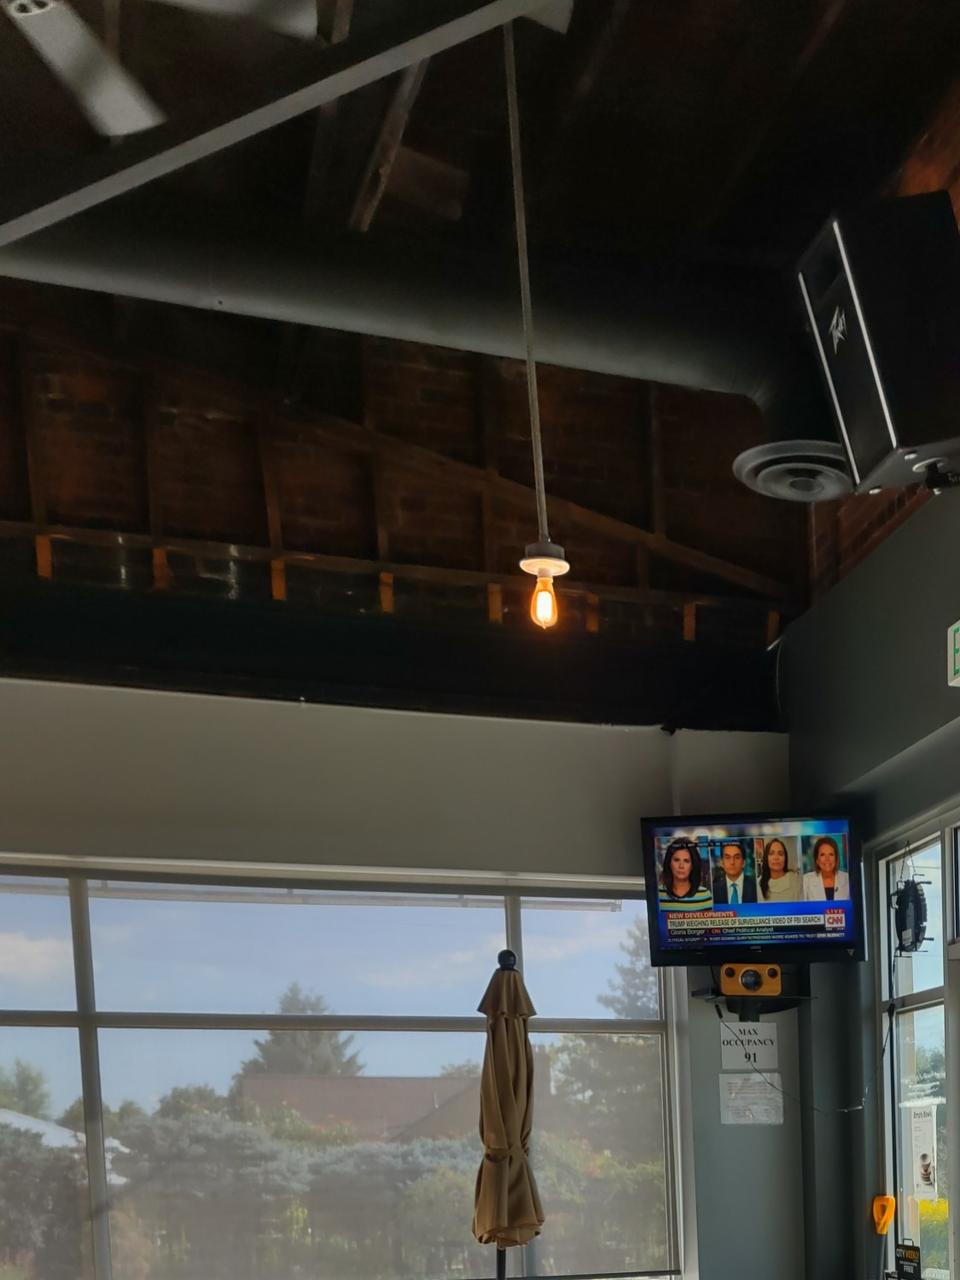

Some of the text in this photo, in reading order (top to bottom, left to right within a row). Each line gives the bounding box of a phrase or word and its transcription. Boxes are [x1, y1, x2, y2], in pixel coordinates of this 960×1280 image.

[738, 917, 770, 926] SURVEILLANCE
[786, 916, 793, 924] OF
[827, 916, 843, 925] CNN
[738, 1028, 759, 1036] MAX
[722, 1038, 775, 1047] OCCUPANCY
[744, 1052, 758, 1063] 91
